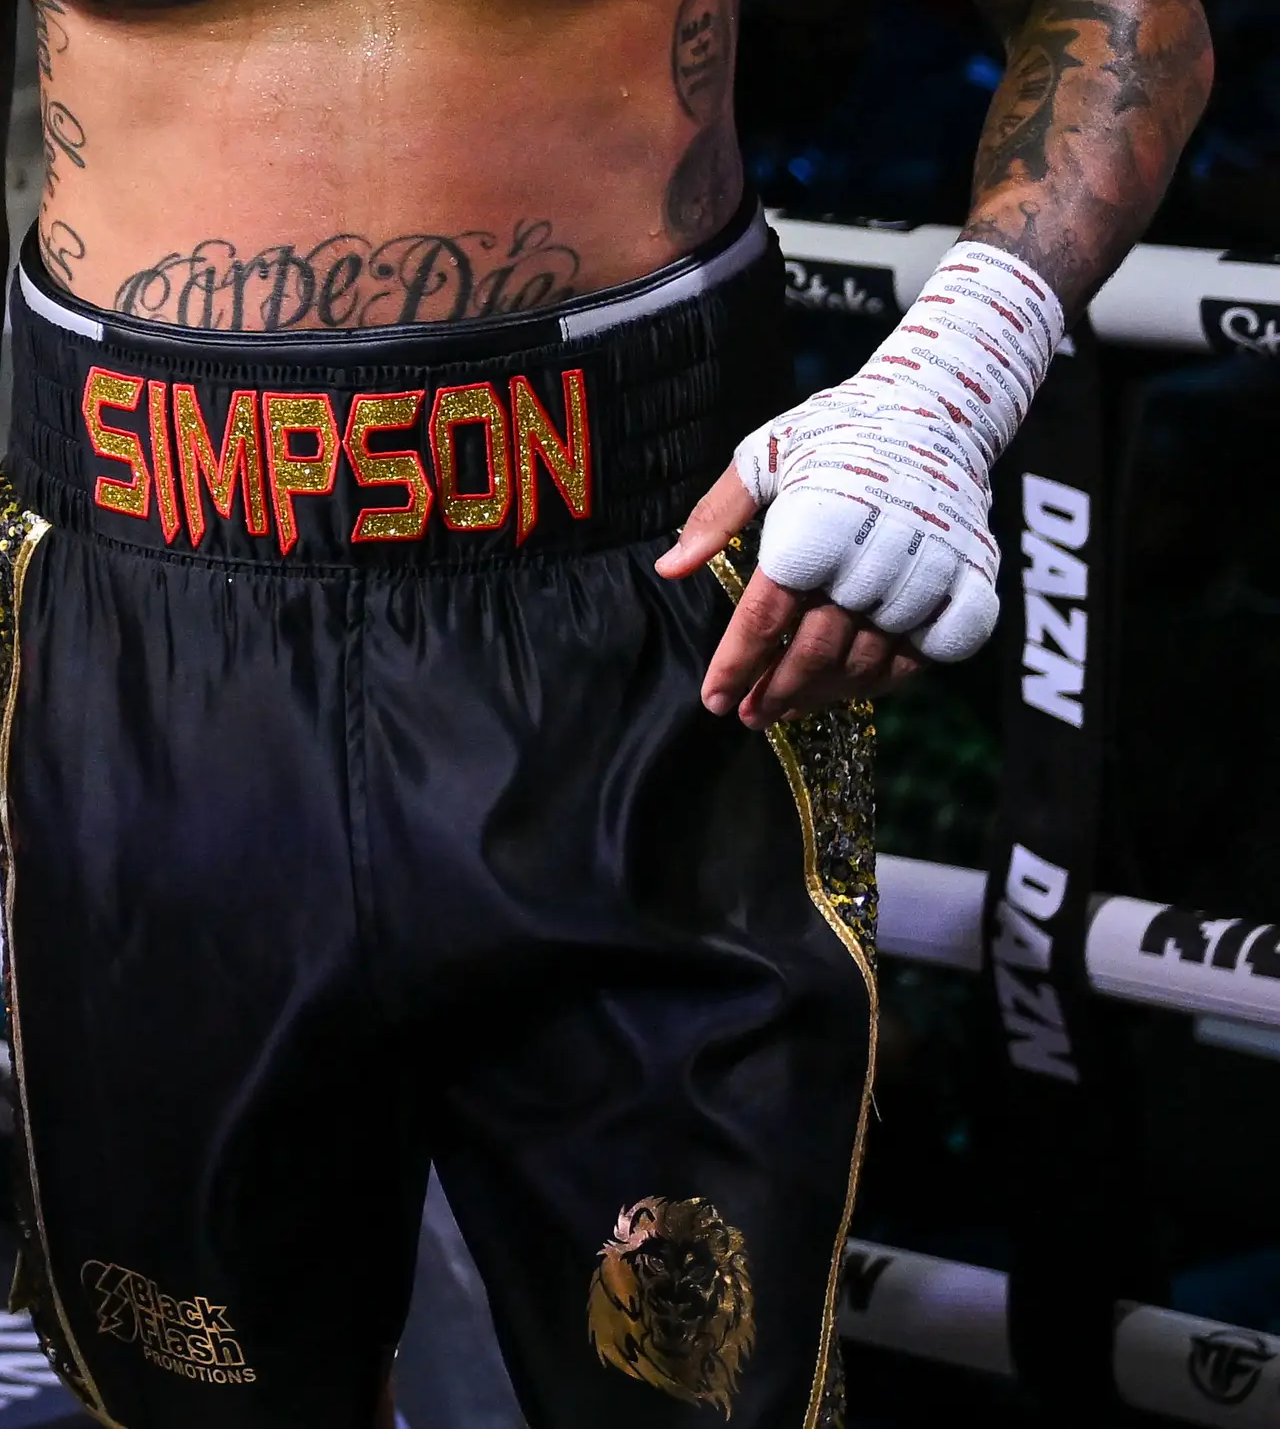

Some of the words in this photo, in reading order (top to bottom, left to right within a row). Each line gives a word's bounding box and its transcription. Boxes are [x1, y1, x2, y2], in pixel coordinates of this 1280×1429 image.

[81, 366, 591, 555] SIMPSON
[1021, 473, 1091, 729] DAZN
[990, 844, 1080, 1083] DAZN
[130, 1271, 236, 1332] Black
[139, 1307, 246, 1366] Flash
[143, 1345, 257, 1384] PROMOTIONS
